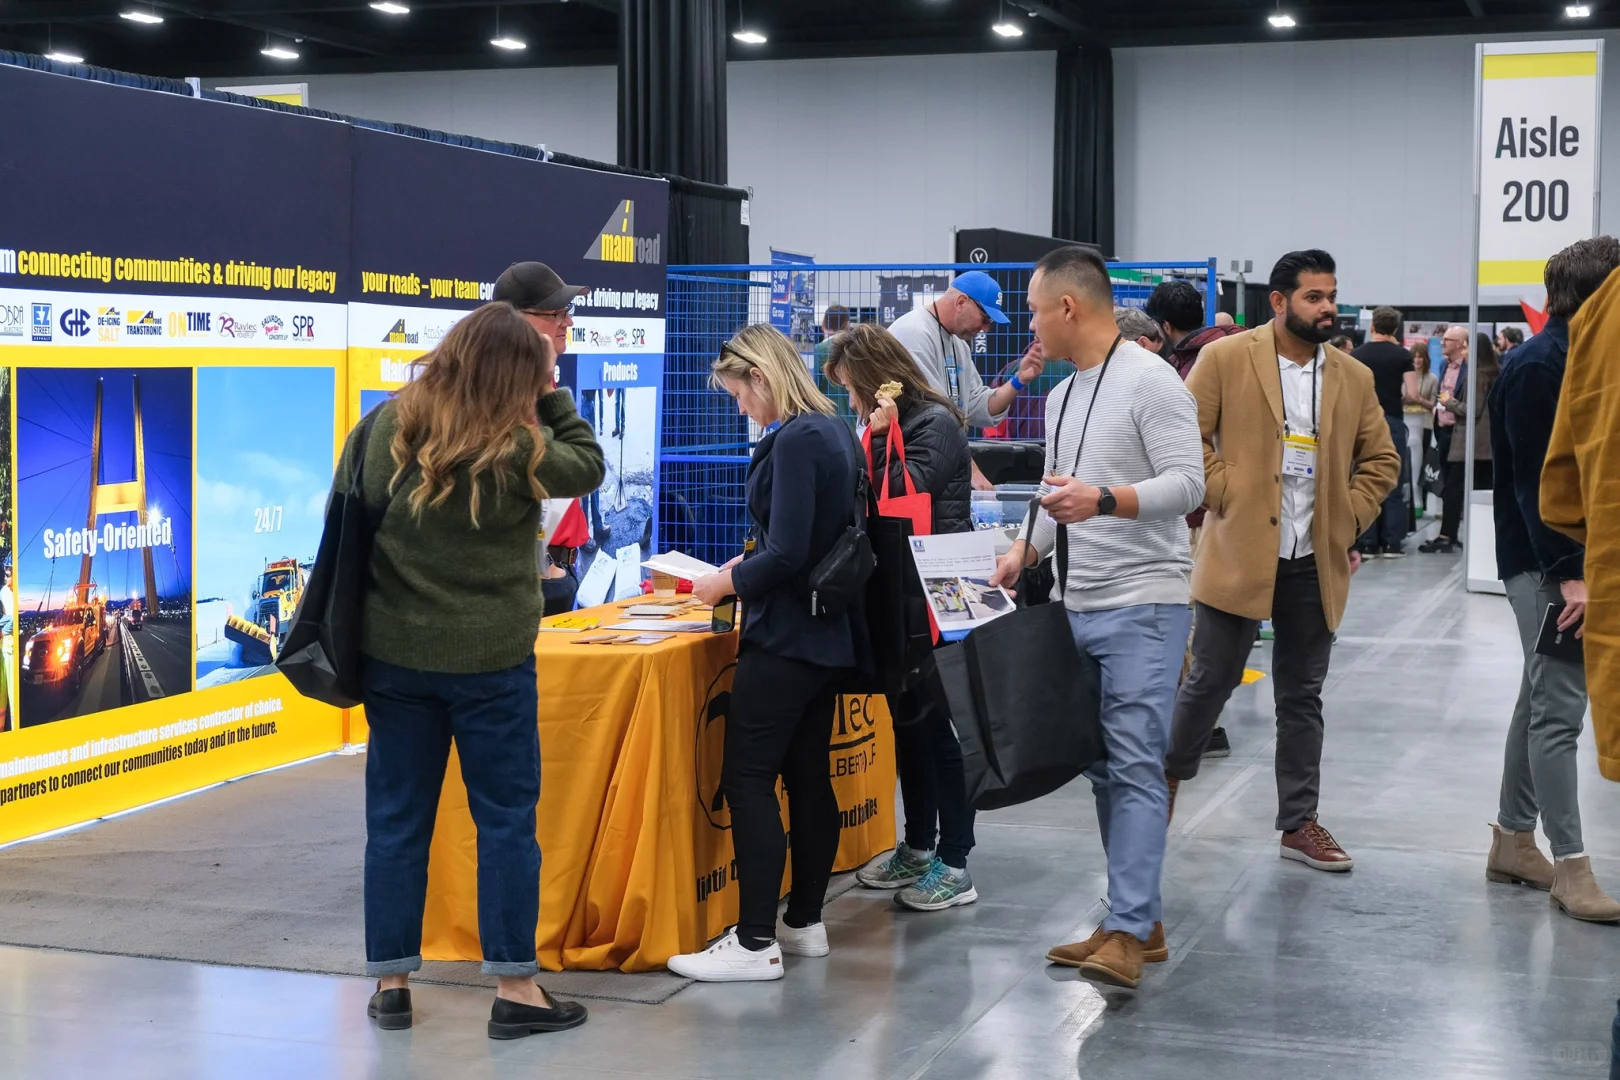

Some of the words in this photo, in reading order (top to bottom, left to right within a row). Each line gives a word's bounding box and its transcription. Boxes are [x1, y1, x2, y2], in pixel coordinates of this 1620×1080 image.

[1495, 116, 1579, 158] Aisle
[1502, 179, 1569, 222] 200
[601, 233, 660, 264] mainroad
[18, 250, 112, 283] connecting
[115, 257, 211, 285] communities
[213, 263, 223, 285] &
[225, 260, 271, 291] driving
[274, 267, 295, 289] our
[297, 265, 337, 294] legacy
[362, 271, 388, 293] your
[390, 273, 420, 295] roads
[430, 278, 454, 299] your
[455, 278, 480, 300] team
[594, 288, 620, 310] driving
[621, 291, 634, 308] our
[635, 289, 659, 311] legacy
[0, 304, 23, 326] OBRA
[98, 317, 120, 326] DE-ICING
[292, 315, 314, 337] SPR
[33, 326, 51, 335] STREET
[98, 327, 120, 342] SALT
[126, 325, 162, 335] TRANSTRONIC
[389, 331, 418, 344] mainroad
[632, 328, 645, 345] SPR
[603, 361, 638, 382] Products
[254, 506, 282, 534] 24/7
[43, 517, 172, 559] Safety-Oriented
[70, 741, 89, 763] and
[91, 727, 158, 758] infrastructure
[160, 718, 198, 741] services
[199, 706, 244, 729] contractor
[245, 701, 254, 718] of
[254, 697, 283, 716] choice.
[0, 779, 46, 806] partners
[49, 776, 58, 792] to
[61, 763, 102, 789] connect
[104, 761, 120, 778] our
[122, 744, 182, 773] communities
[184, 737, 208, 756] today
[210, 731, 225, 750] and
[227, 729, 235, 745] in
[237, 726, 250, 743] the
[251, 721, 277, 739] future.
